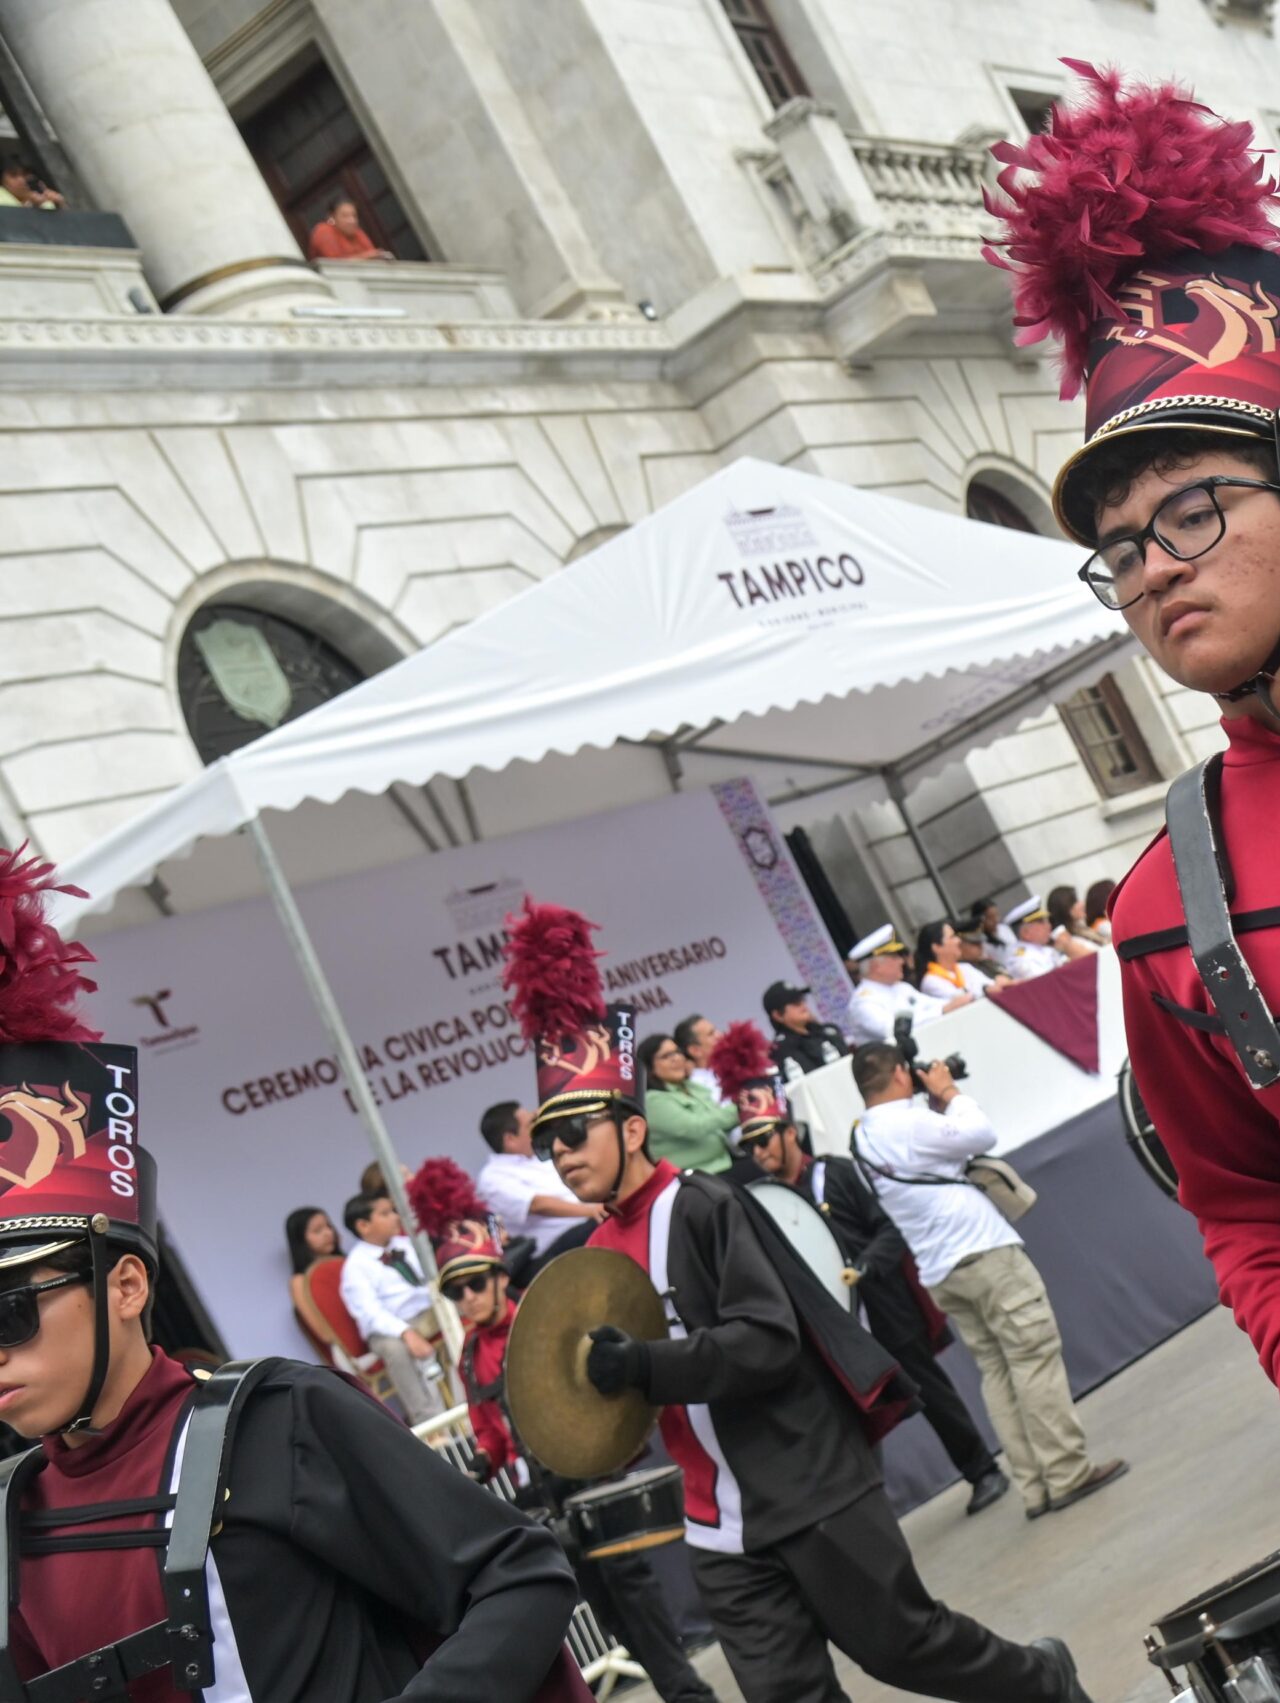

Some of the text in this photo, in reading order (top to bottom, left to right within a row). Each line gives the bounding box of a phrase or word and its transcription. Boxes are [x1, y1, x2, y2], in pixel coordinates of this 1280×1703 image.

[717, 553, 864, 609] TAMPICO
[221, 1045, 385, 1116] CEREMOIA
[383, 1016, 473, 1062] CIVICA
[605, 936, 727, 991] ANIVERSARIO
[617, 1011, 634, 1081] TOROS
[381, 1070, 419, 1101] LA
[417, 1033, 530, 1089] REVOLUC
[105, 1064, 136, 1197] TOROS
